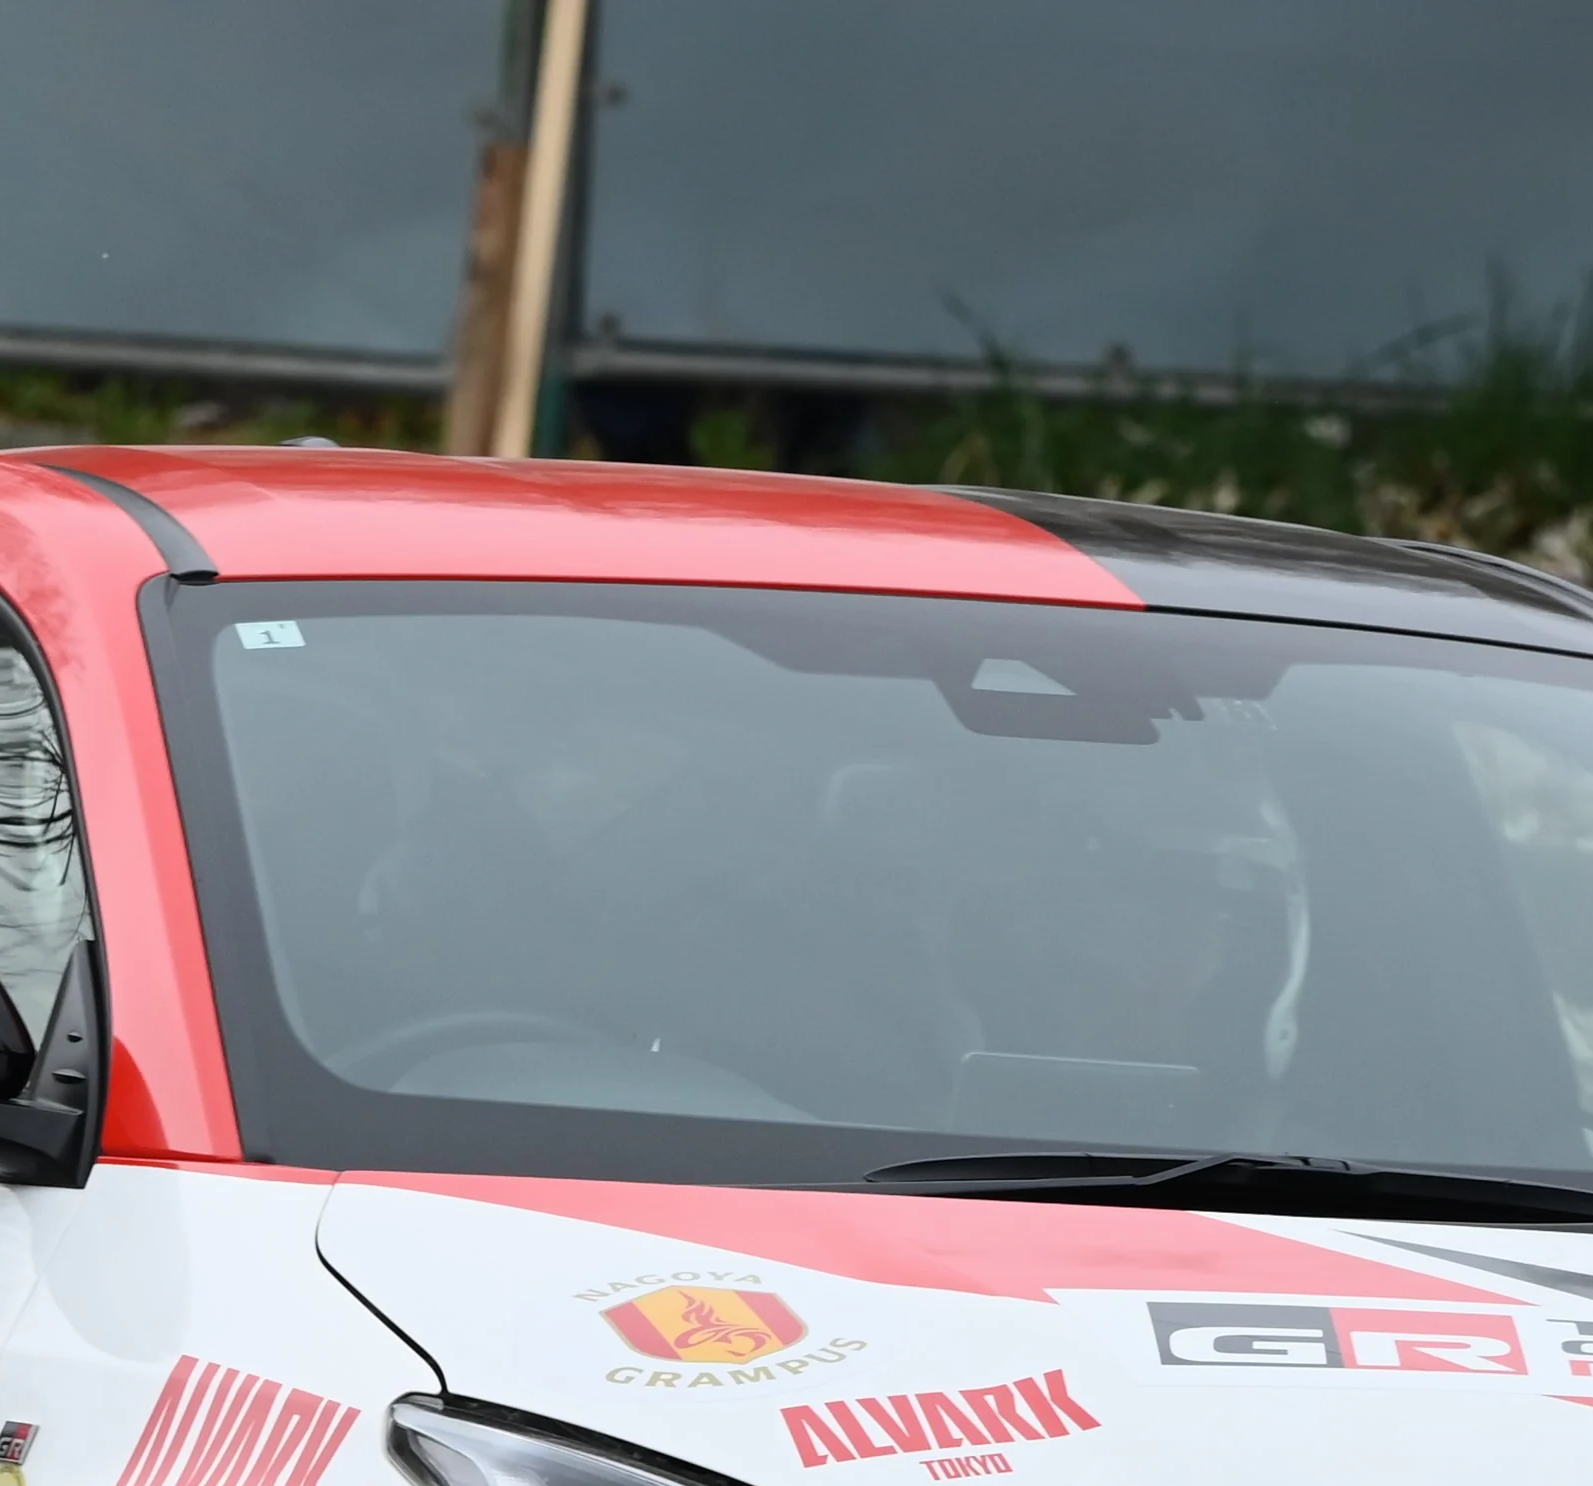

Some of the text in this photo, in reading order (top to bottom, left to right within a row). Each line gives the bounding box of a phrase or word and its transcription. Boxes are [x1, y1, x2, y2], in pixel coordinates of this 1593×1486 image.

[572, 1270, 765, 1304] NAGOYA
[604, 1335, 869, 1389] GRAMPUS
[1165, 1326, 1515, 1373] GR
[779, 1368, 1103, 1469] ALVARK
[919, 1451, 1015, 1482] TOKYO
